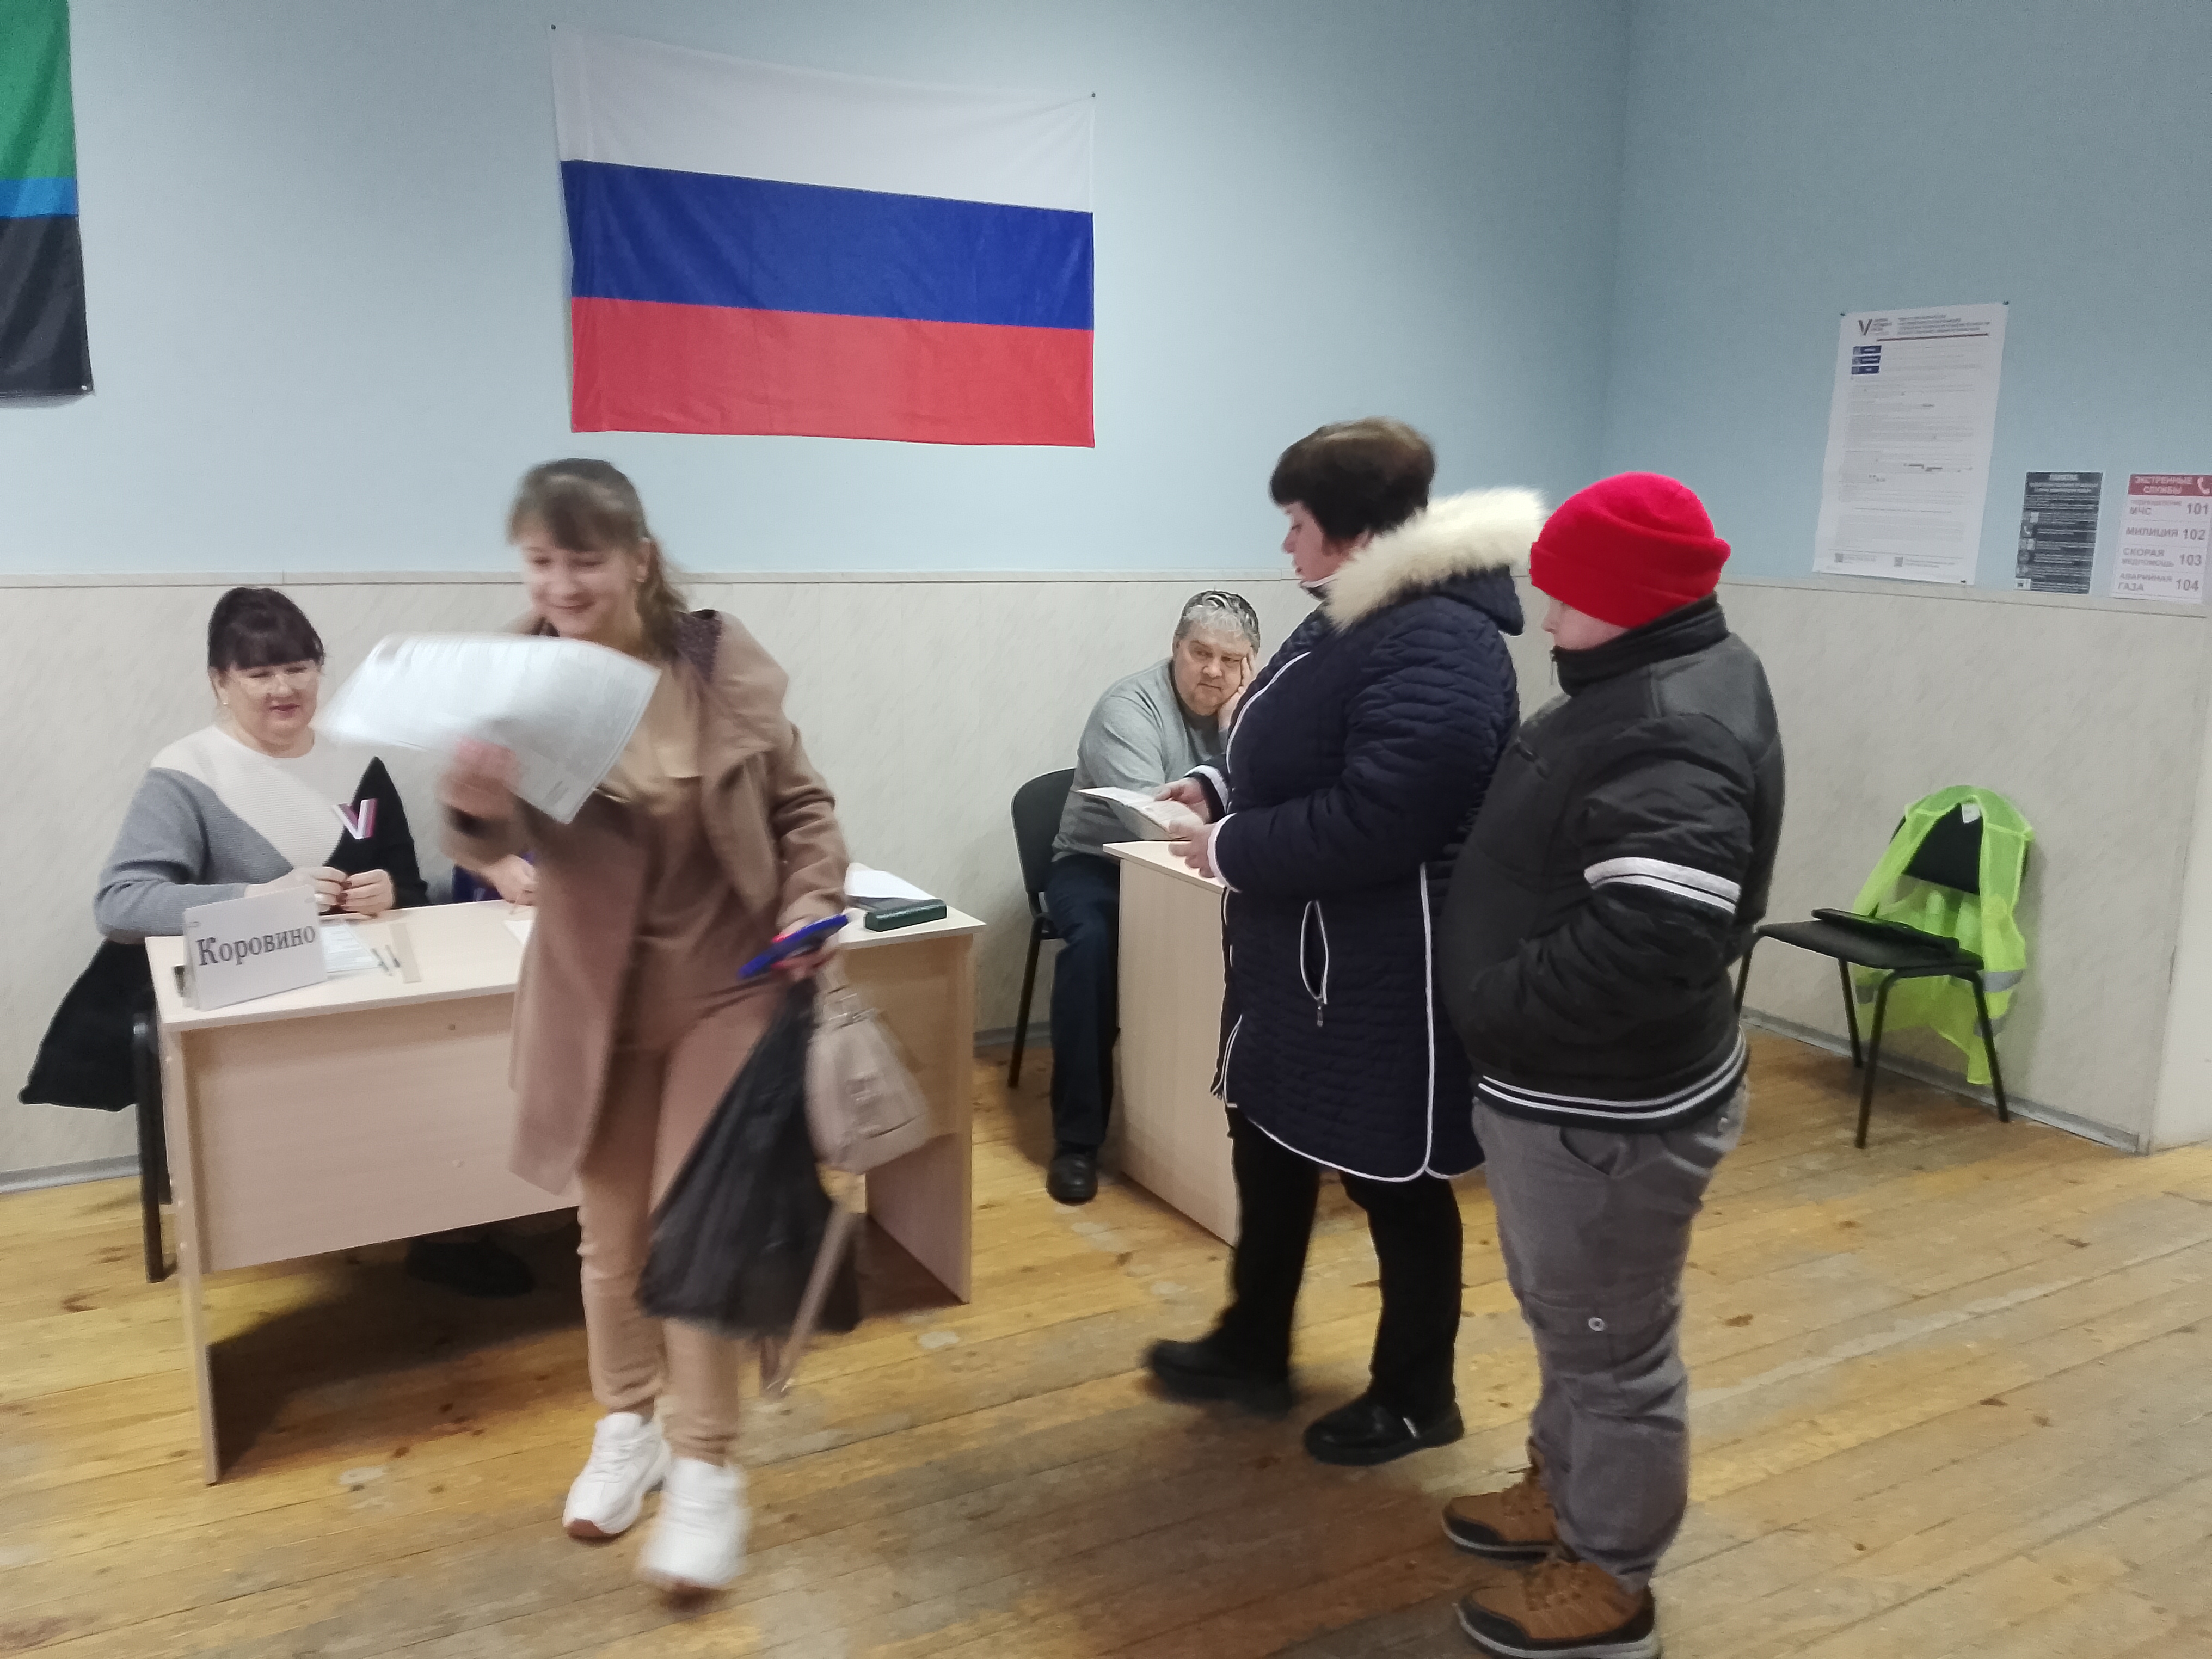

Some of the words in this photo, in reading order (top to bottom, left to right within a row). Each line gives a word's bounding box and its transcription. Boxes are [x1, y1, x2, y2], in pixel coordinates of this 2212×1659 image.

[2187, 503, 2208, 515] 101
[2126, 527, 2178, 537] МИЛИЦИЯ
[2183, 529, 2205, 540] 102
[2123, 548, 2165, 557] СКОРАЯ
[2179, 554, 2202, 566] 103
[2117, 582, 2143, 591] ГАЗА
[2176, 579, 2199, 591] 104
[196, 925, 315, 966] Коровино
